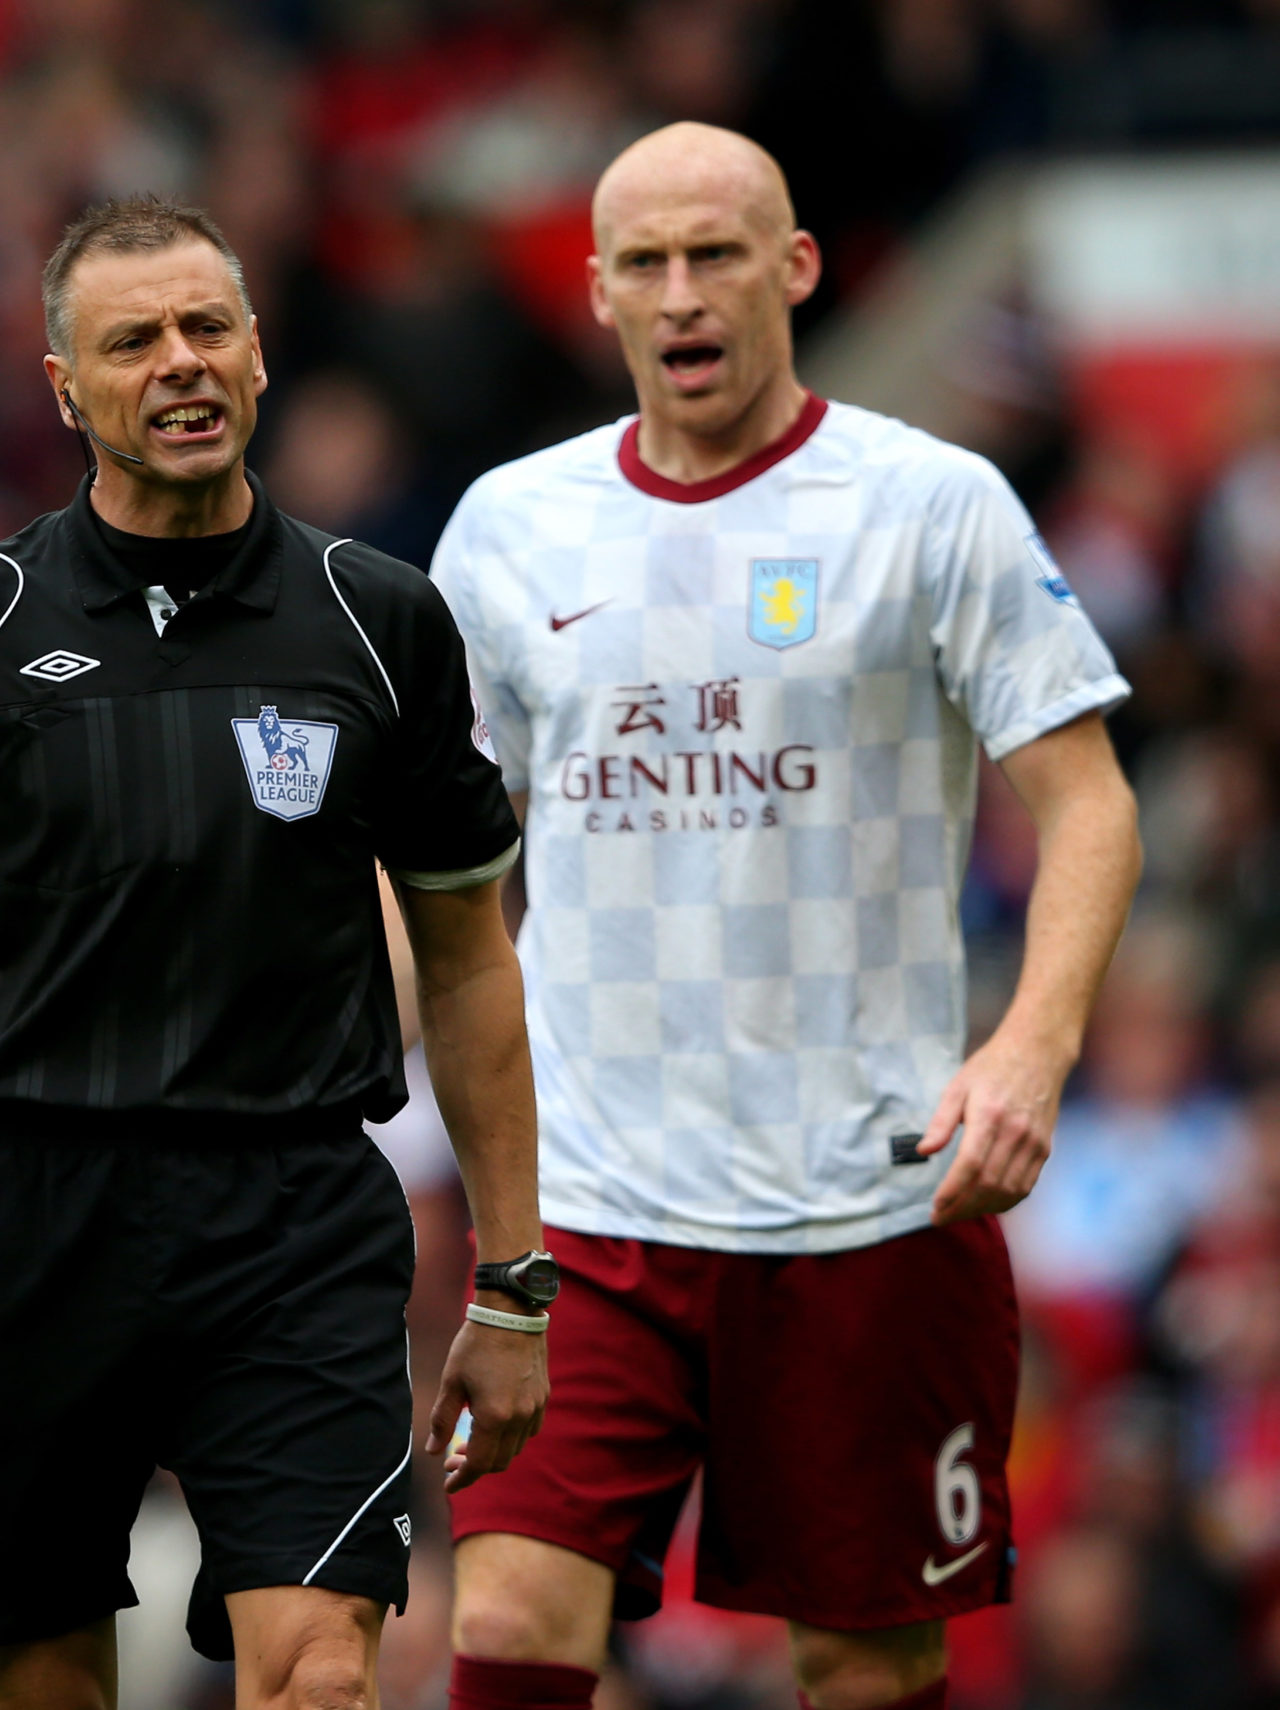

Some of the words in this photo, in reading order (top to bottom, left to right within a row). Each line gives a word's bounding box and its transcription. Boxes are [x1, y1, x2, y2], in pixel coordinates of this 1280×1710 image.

[609, 676, 743, 737] 云顶
[257, 771, 319, 789] PREMIER
[560, 744, 818, 802] GENTING
[260, 786, 316, 804] LEAGUE
[584, 804, 780, 833] CASINOS
[934, 1421, 981, 1547] 6
